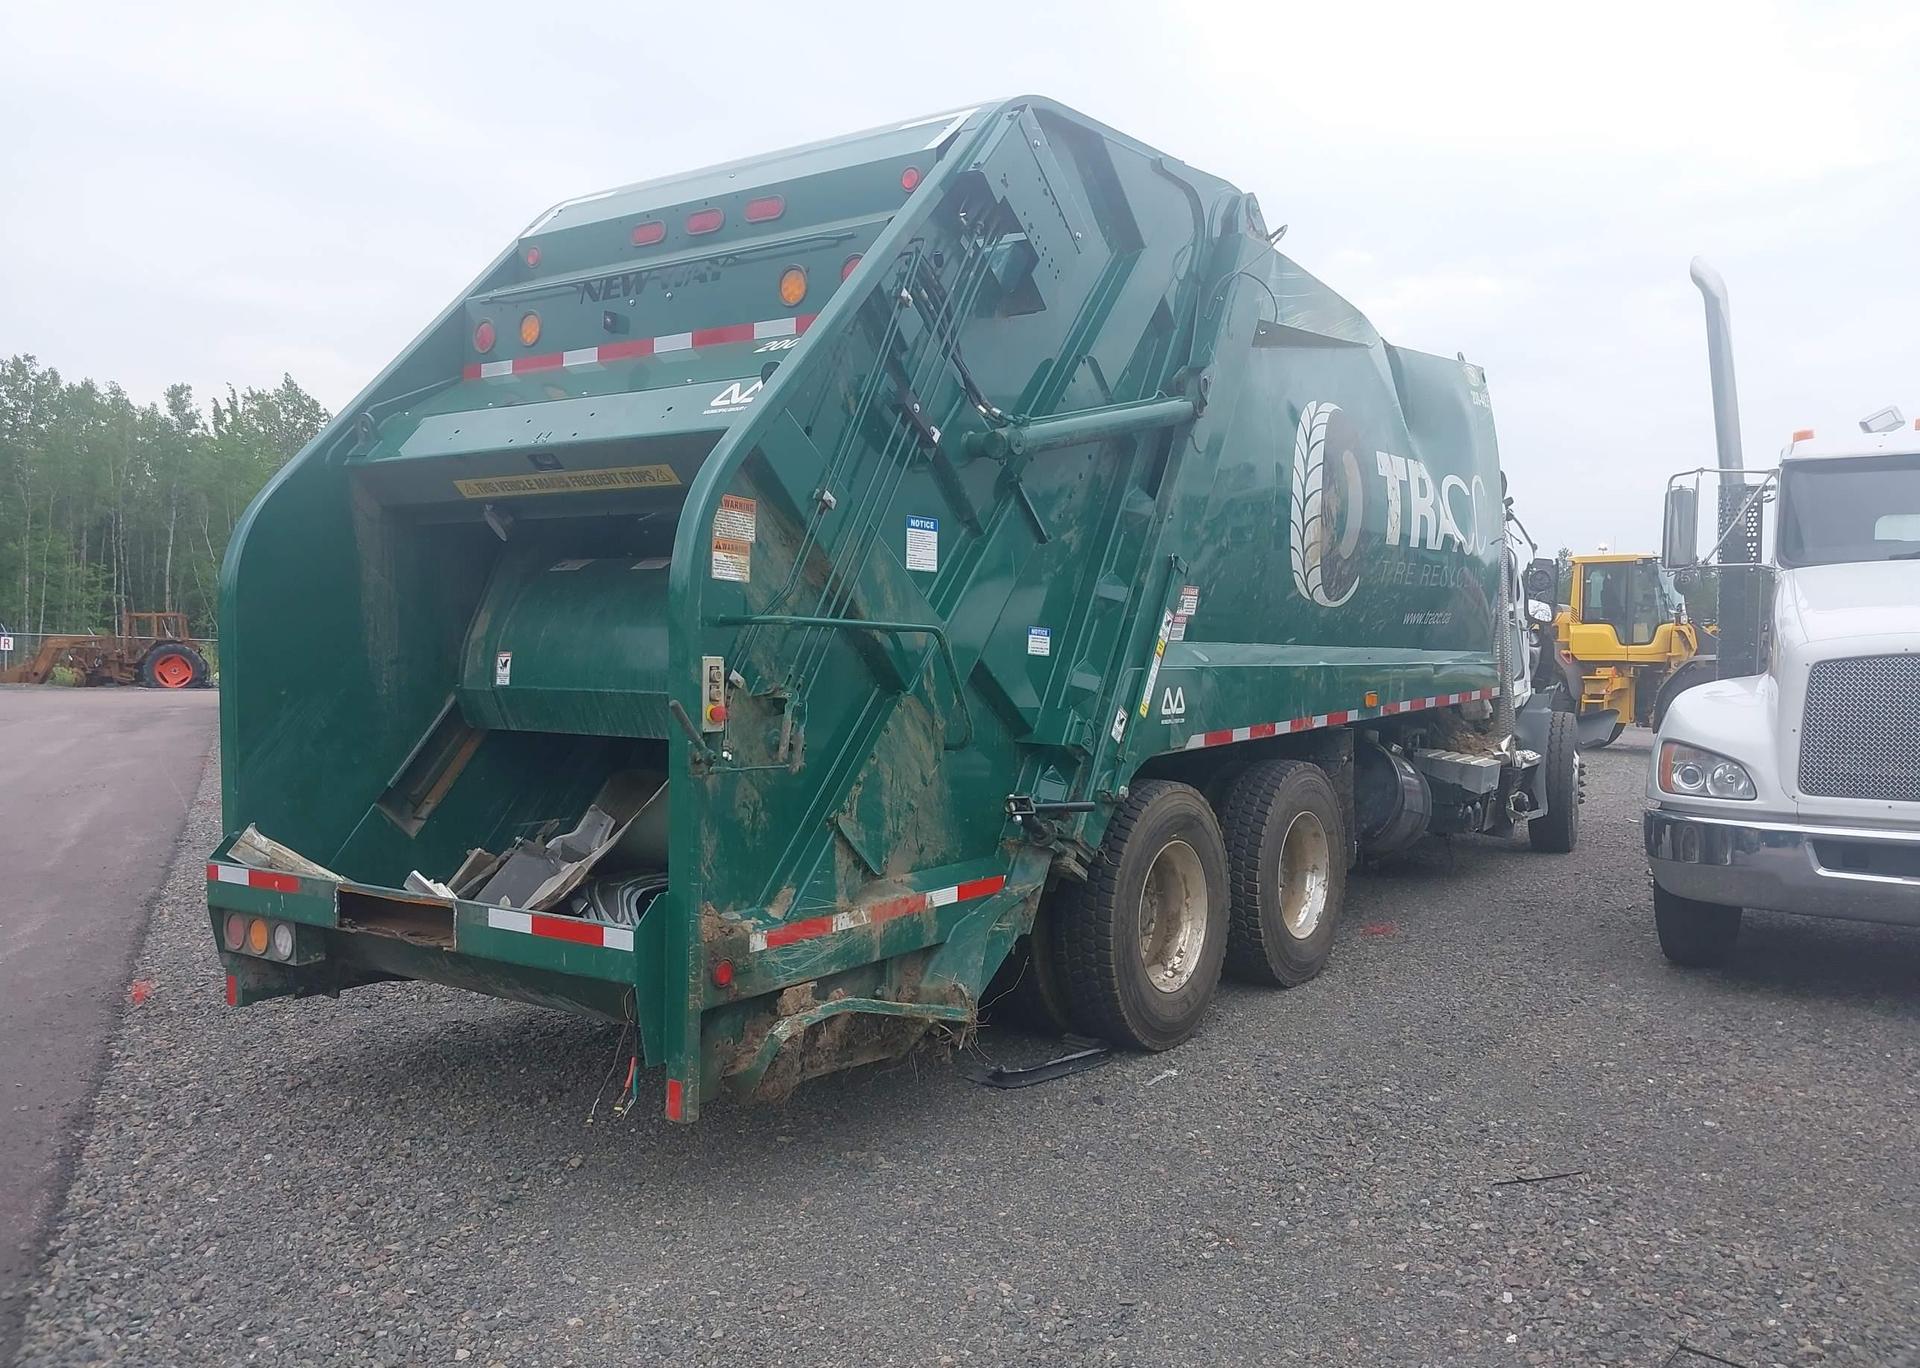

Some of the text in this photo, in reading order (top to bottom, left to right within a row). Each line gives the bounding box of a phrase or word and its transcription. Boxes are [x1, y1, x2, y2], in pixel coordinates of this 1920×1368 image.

[580, 271, 649, 304] NEW
[477, 482, 499, 494] THIS
[498, 478, 538, 493] VEHICLE
[567, 471, 621, 487] FREQUENT
[620, 468, 657, 484] STOPS
[723, 498, 754, 512] WARNING
[910, 518, 934, 530] NOTICE
[1380, 560, 1417, 585] TRE
[1402, 609, 1453, 625] www.tracc.ca
